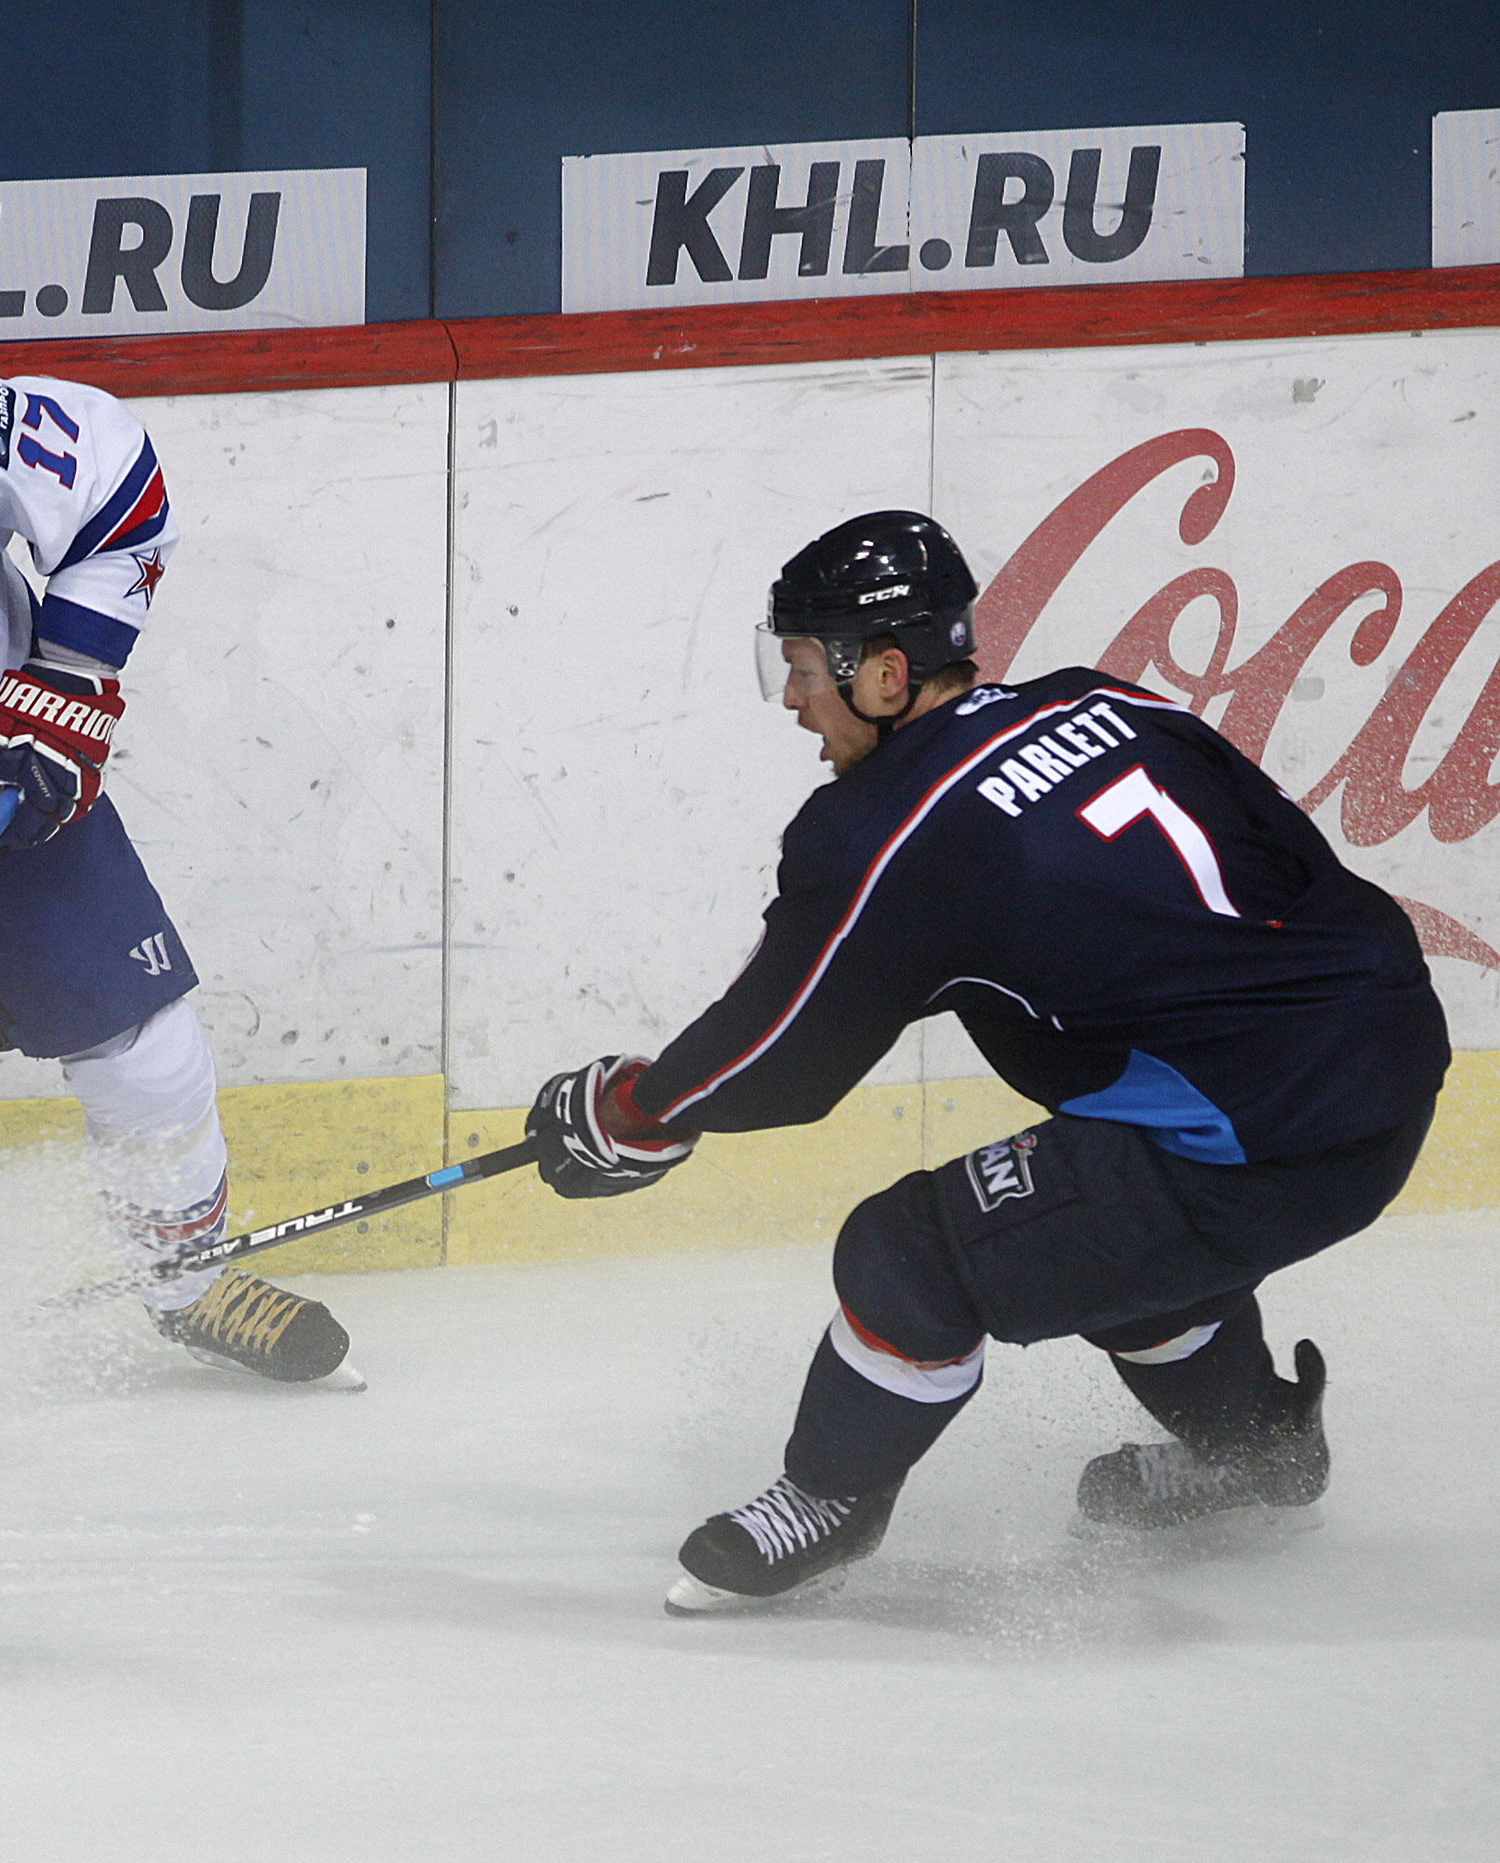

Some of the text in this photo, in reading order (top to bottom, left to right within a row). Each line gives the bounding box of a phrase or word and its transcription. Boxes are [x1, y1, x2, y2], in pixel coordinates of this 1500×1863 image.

[645, 145, 1162, 287] KHL.RU
[17, 391, 80, 491] 17
[858, 584, 911, 605] CCM
[976, 702, 1138, 818] PARLETT
[1075, 762, 1262, 926] 7
[980, 1140, 1019, 1194] AN
[250, 1201, 363, 1246] TRUE
